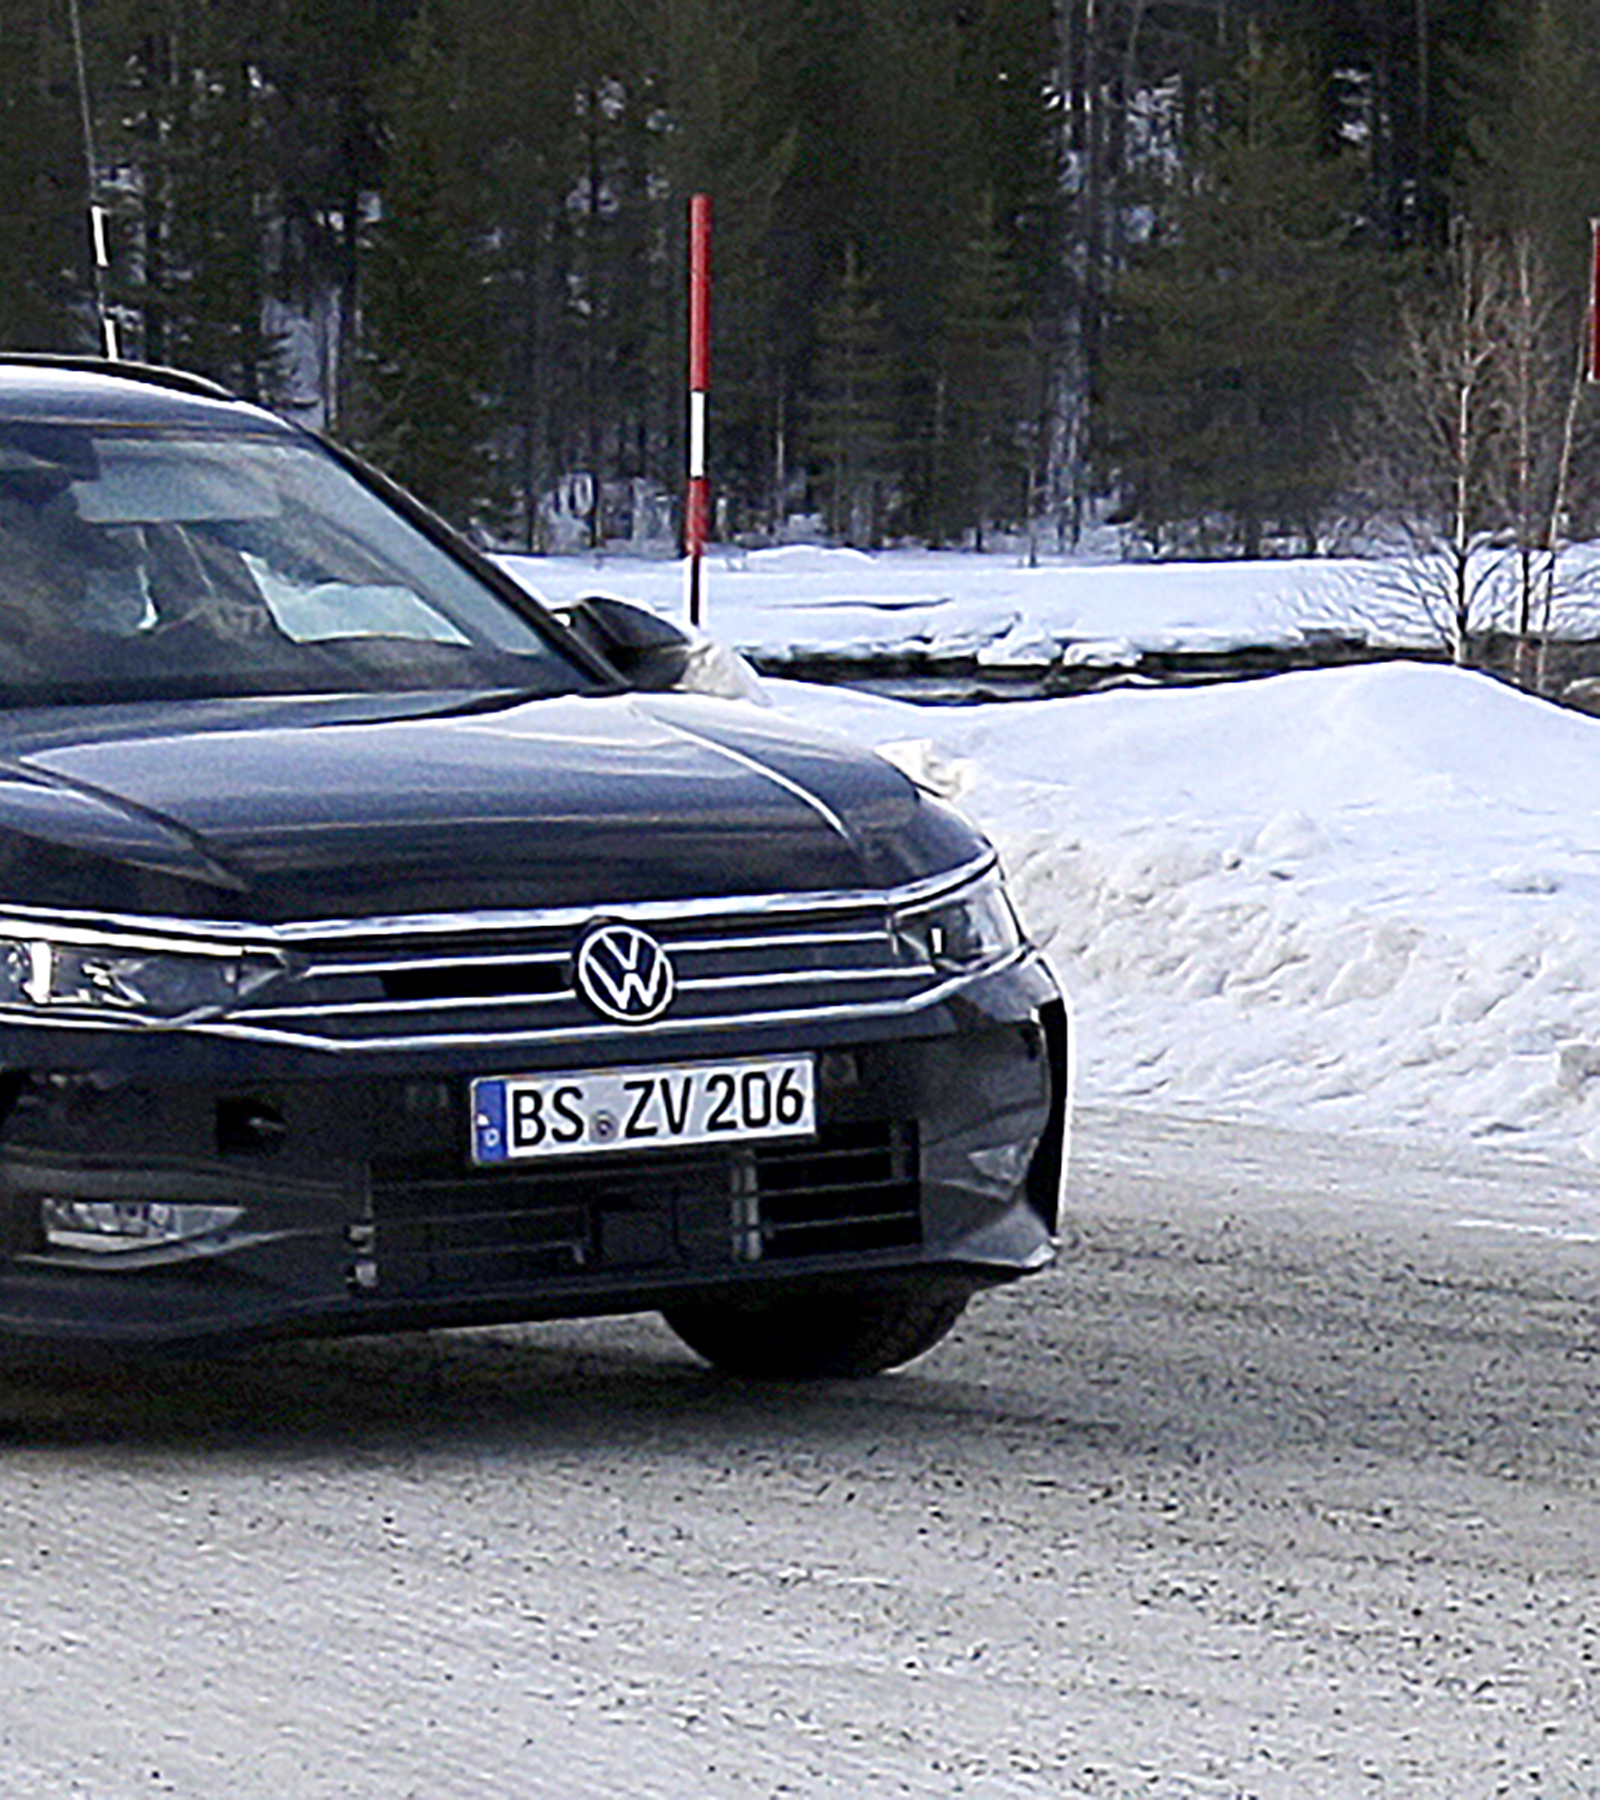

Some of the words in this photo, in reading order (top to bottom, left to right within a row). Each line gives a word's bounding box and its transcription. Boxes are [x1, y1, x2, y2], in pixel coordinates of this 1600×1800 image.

[584, 931, 666, 1013] VW
[513, 1086, 584, 1147] BS
[624, 1077, 692, 1138] ZV
[705, 1068, 804, 1132] 206
